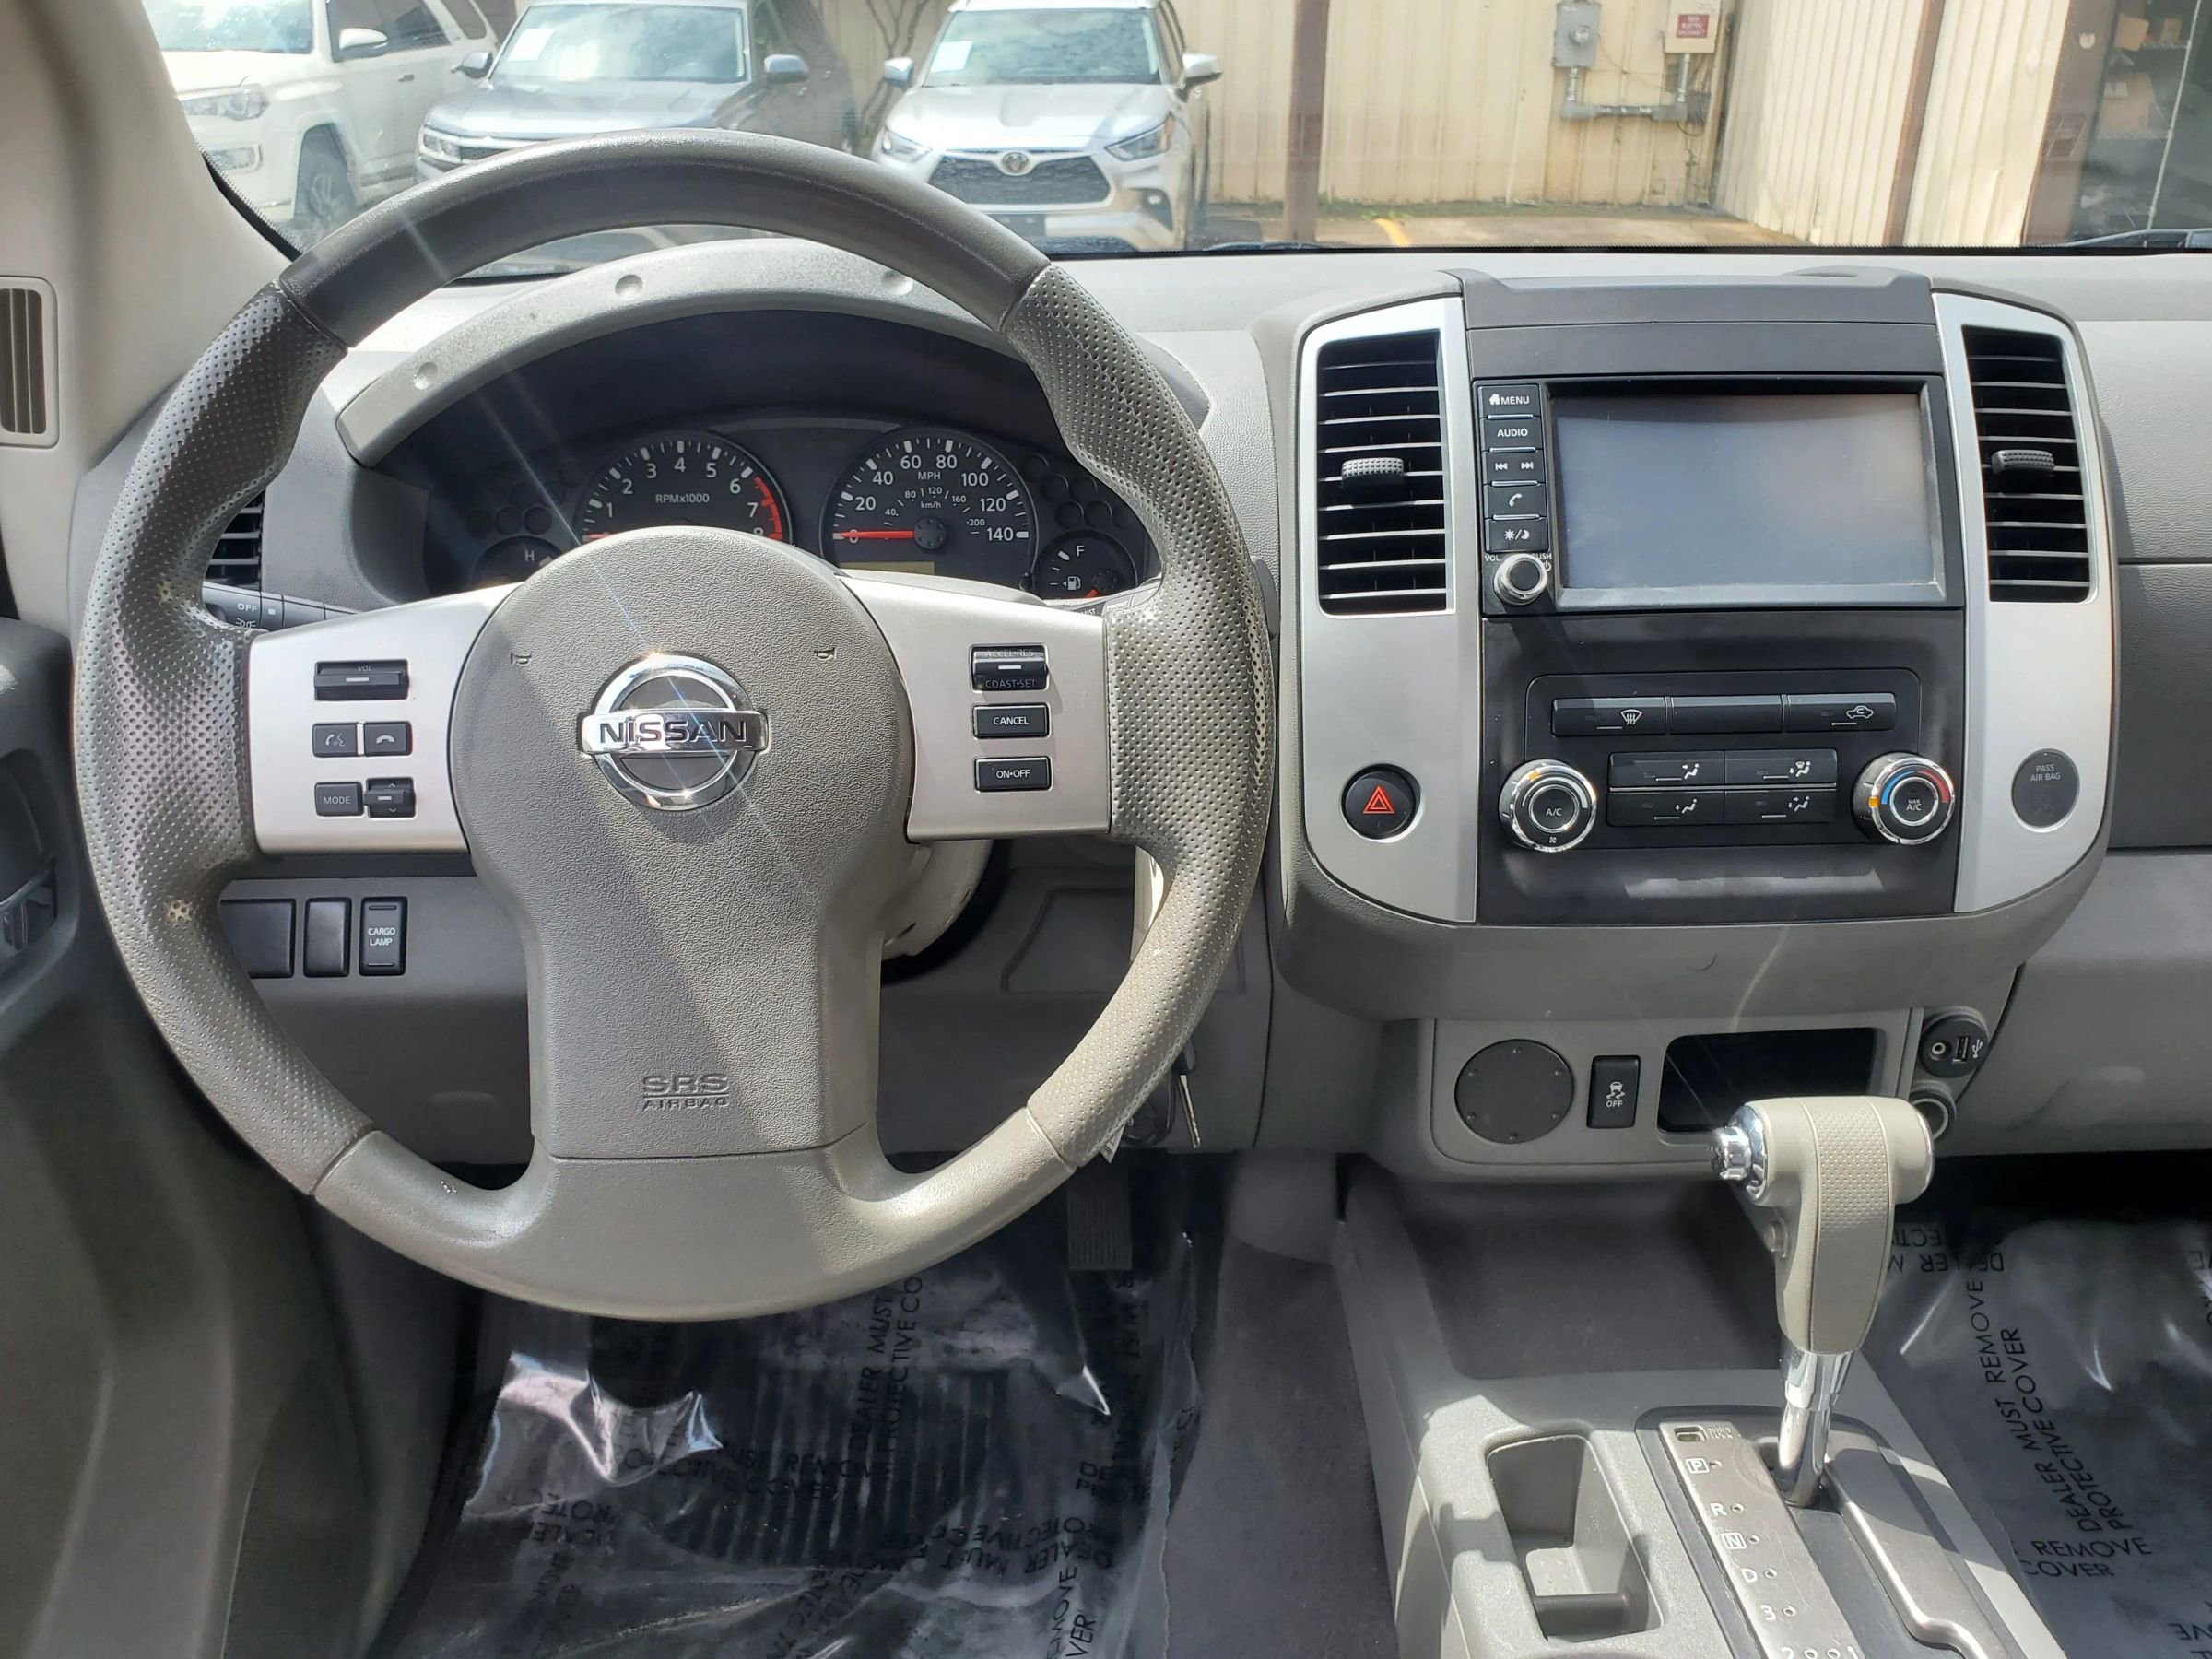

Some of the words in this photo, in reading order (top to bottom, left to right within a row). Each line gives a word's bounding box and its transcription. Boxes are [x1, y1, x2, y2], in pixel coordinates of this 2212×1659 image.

[1500, 396, 1530, 406] MENU
[1497, 429, 1528, 438] AUDIO
[674, 457, 686, 473] 4
[900, 454, 922, 469] 60
[935, 454, 958, 469] 80
[646, 463, 657, 478] 3
[706, 463, 717, 478] 5
[918, 471, 941, 480] MPH
[729, 478, 741, 494] 6
[872, 471, 894, 486] 40
[961, 472, 989, 487] 100
[622, 478, 633, 495] 2
[928, 487, 942, 495] 120
[655, 493, 710, 504] RPMx1000
[904, 490, 916, 499] 80
[952, 495, 966, 503] 160
[606, 502, 613, 518] 1
[747, 502, 759, 518] 7
[855, 496, 877, 511] 20
[921, 501, 941, 510] km/h
[980, 498, 1006, 512] 120
[987, 527, 1014, 542] 140
[524, 550, 535, 561] H
[1076, 545, 1085, 557] F
[1484, 554, 1500, 562] VOL
[237, 603, 259, 613] OFF
[993, 716, 1029, 725] CANCEL
[599, 719, 747, 745] NISSAN
[2036, 764, 2054, 772] PASS
[2030, 773, 2043, 782] AIR
[2045, 772, 2061, 781] BAG
[323, 796, 351, 805] MODE
[1906, 803, 1922, 811] A/C
[1546, 808, 1563, 817] A/C
[368, 927, 396, 935] CARGO
[370, 938, 393, 947] LAMP
[642, 1073, 730, 1096] SRS
[1606, 1100, 1623, 1108] OFF
[866, 1294, 895, 1354] MUST
[1967, 1280, 2006, 1383] REMOVE
[2000, 1327, 2043, 1414] COVER
[1994, 1397, 2041, 1450] MUST
[2032, 1419, 2132, 1530] PROTECTIVE
[2034, 1462, 2102, 1533] DEALER
[1710, 1502, 1727, 1517] R
[2030, 1536, 2154, 1558] REMOVE
[1740, 1568, 1759, 1583] D
[2018, 1559, 2116, 1578] COVER
[1759, 1604, 1776, 1621] 3
